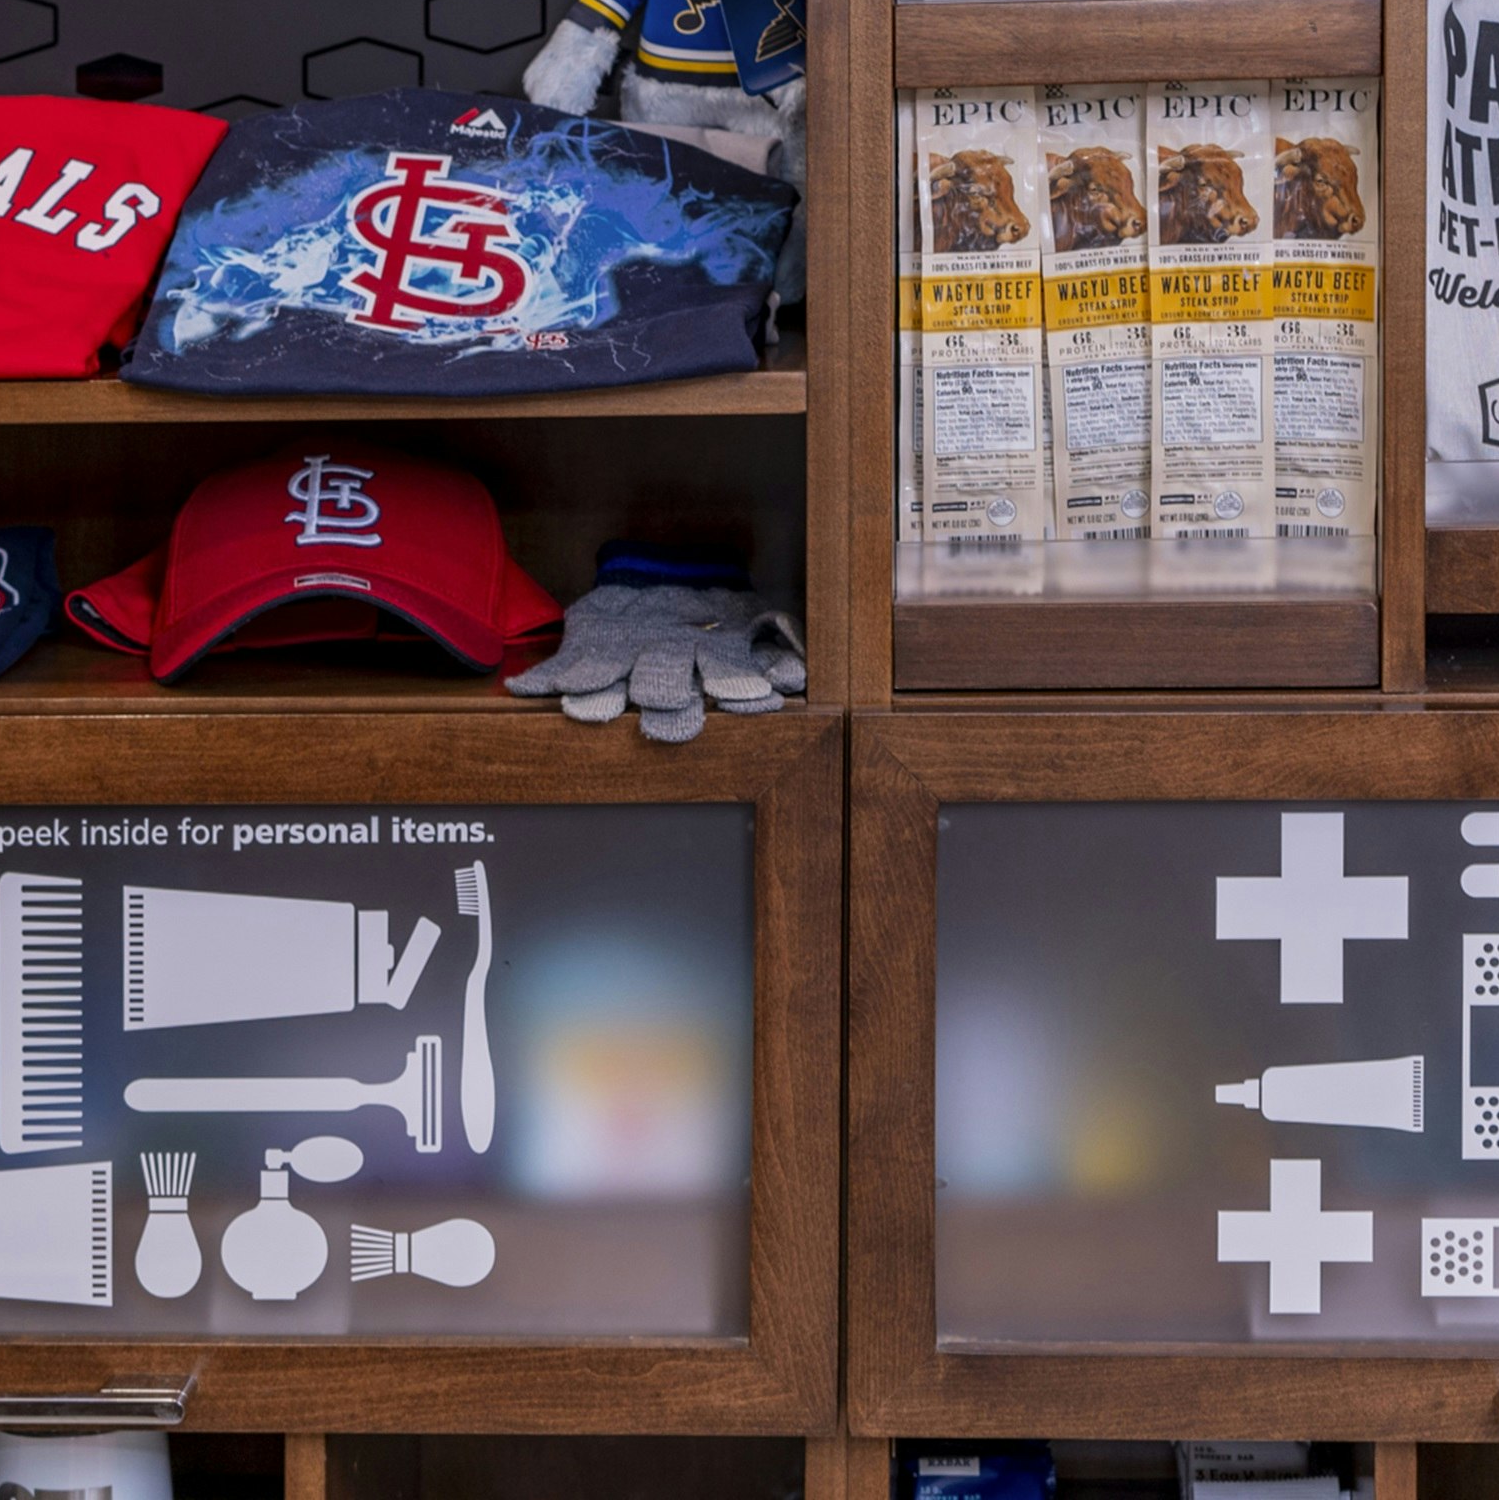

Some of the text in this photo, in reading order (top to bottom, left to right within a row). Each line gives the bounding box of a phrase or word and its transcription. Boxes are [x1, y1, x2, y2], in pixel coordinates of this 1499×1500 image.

[1046, 96, 1136, 127] EPIC
[1163, 93, 1252, 119] EPIC
[1283, 88, 1368, 113] EPIC
[933, 100, 1023, 126] EPIC
[450, 122, 507, 141] Majestic
[932, 280, 1034, 303] WAGYU BEEF
[1161, 273, 1261, 294] WAGYU BEEF
[953, 304, 1012, 316] STEAK STRIP
[1180, 296, 1239, 308] STEAK STRIP
[932, 349, 979, 358] PROTEIN
[1012, 346, 1034, 355] CARBS
[936, 369, 994, 379] Nutrition Facts
[81, 817, 168, 846] inside
[177, 817, 223, 845] for
[232, 816, 379, 851] personal
[391, 816, 495, 844] items.
